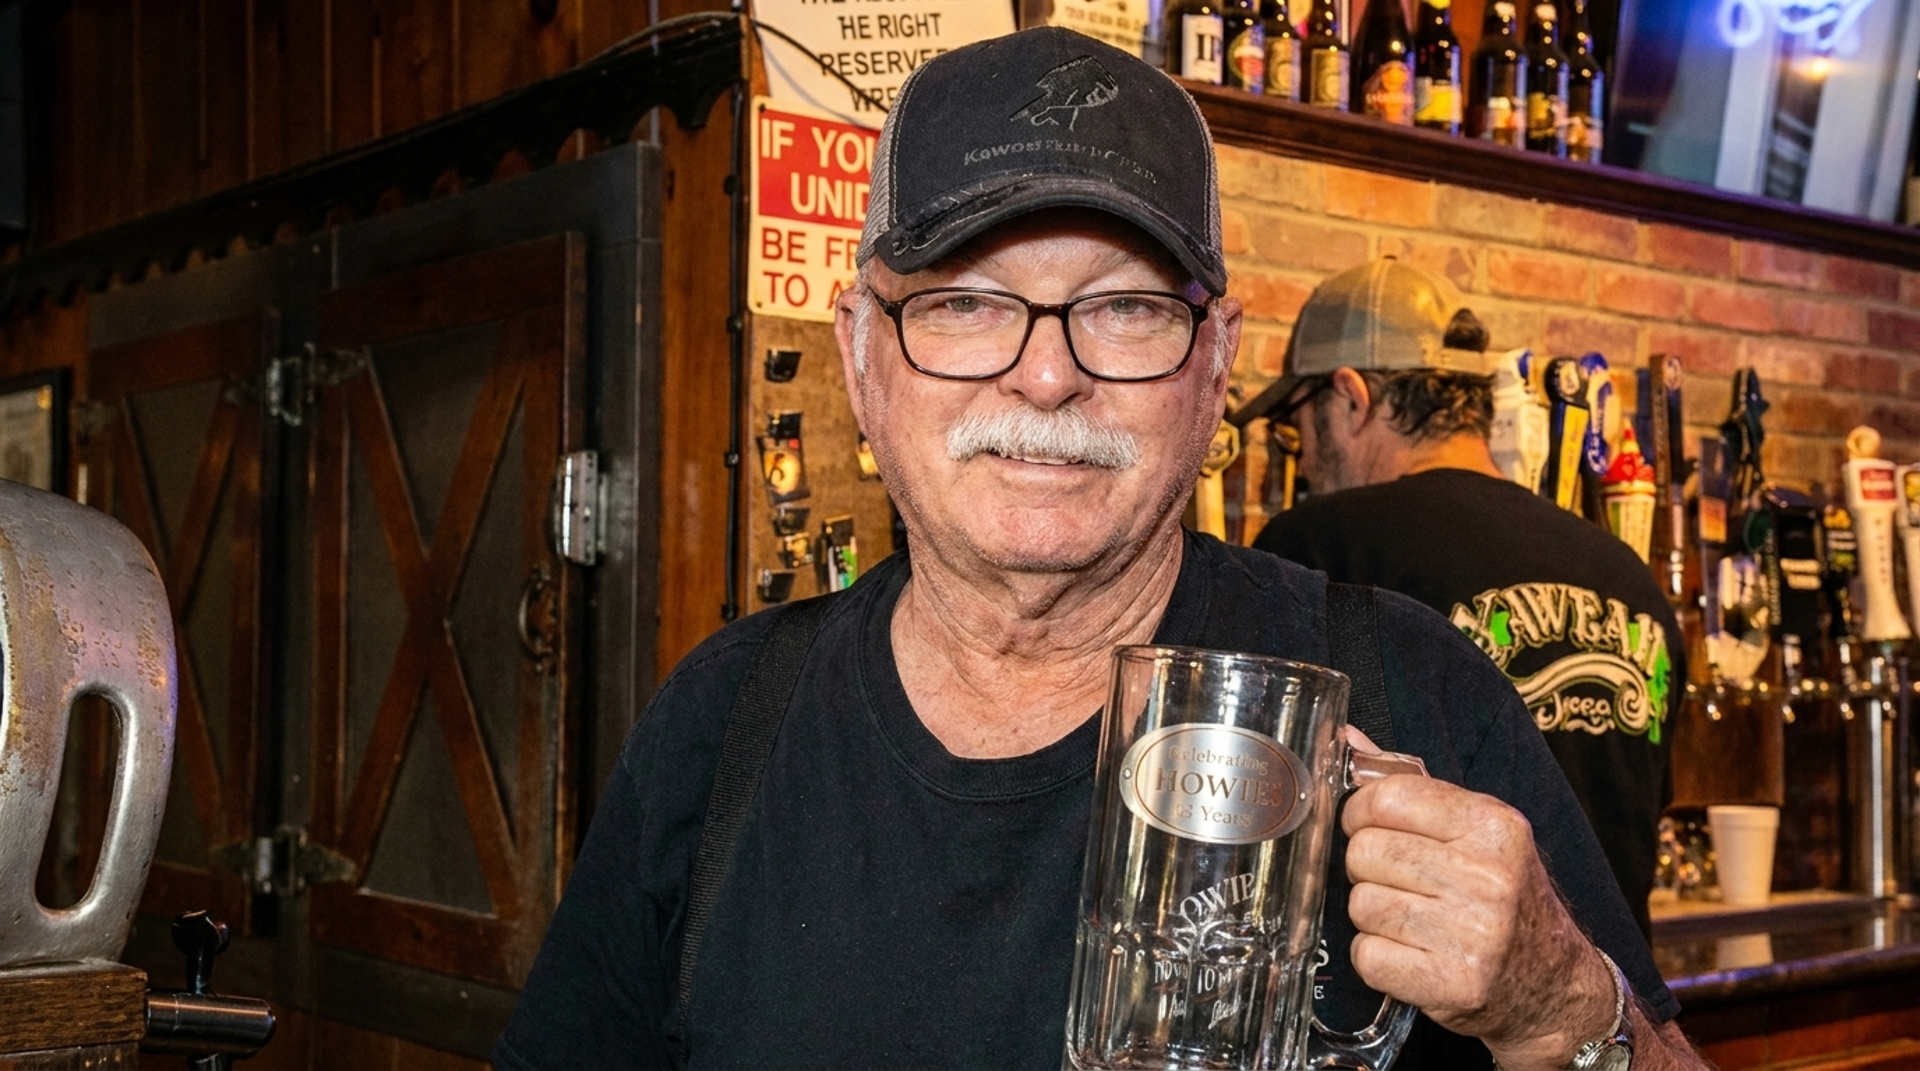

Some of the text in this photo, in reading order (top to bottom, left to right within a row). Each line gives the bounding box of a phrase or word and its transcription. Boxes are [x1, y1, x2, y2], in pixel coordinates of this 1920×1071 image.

[878, 13, 942, 39] RIGHT
[761, 118, 796, 160] IF
[762, 227, 806, 264] BE
[763, 271, 809, 308] TO
[1201, 805, 1251, 828] Years
